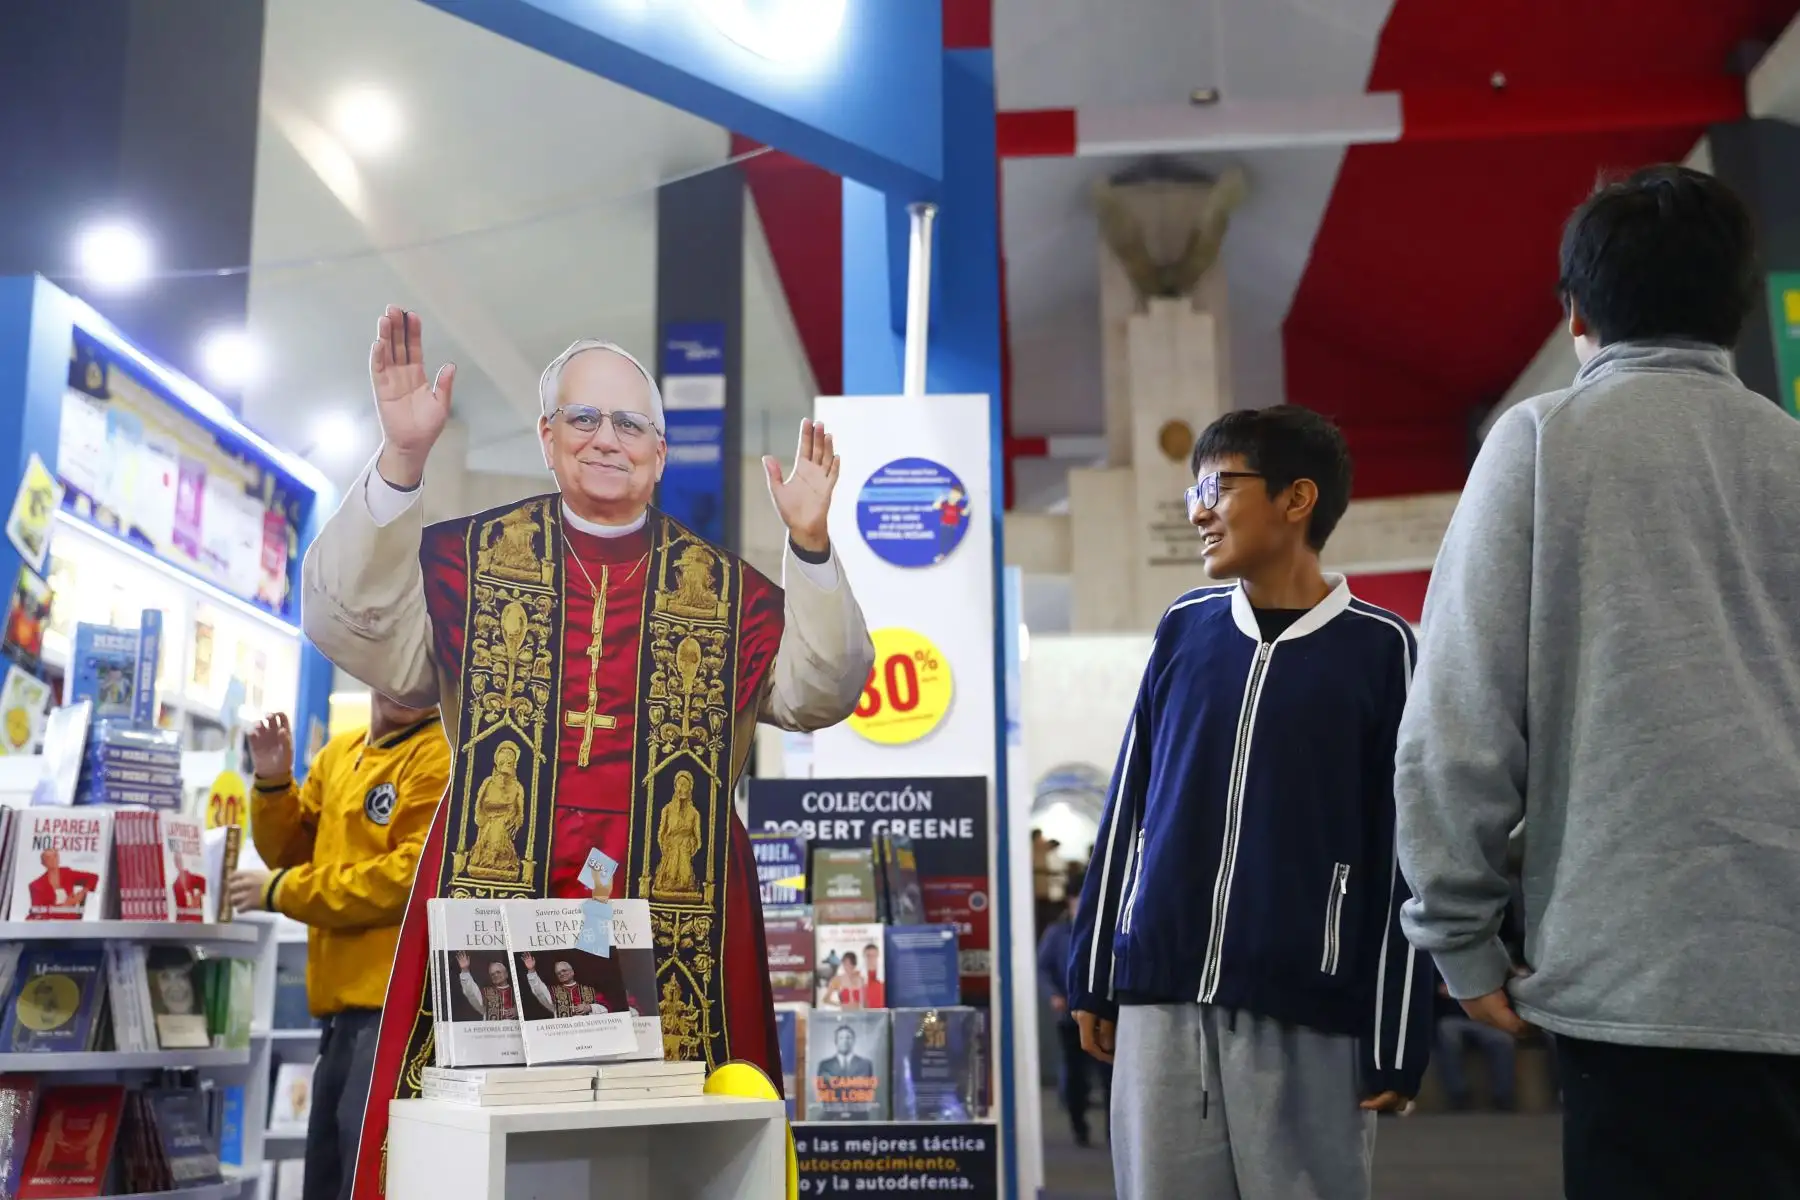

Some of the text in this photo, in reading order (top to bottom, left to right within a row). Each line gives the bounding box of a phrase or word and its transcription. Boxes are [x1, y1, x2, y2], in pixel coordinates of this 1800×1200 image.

[801, 785, 933, 813] COLECCIÓN
[33, 817, 100, 834] LA PAREJA
[871, 817, 974, 839] GREENE
[31, 835, 100, 852] NO EXISTE
[535, 908, 560, 917] Saverio
[474, 920, 488, 932] EL
[535, 921, 550, 933] EL
[612, 919, 629, 931] PA
[613, 933, 637, 945] XIV
[545, 1022, 573, 1031] HISTORIA
[813, 1137, 839, 1152] las
[844, 1136, 917, 1156] mejores
[922, 1135, 986, 1152] táctica
[815, 1178, 827, 1195] y
[832, 1175, 850, 1191] la
[854, 1173, 975, 1191] autodefensa.
